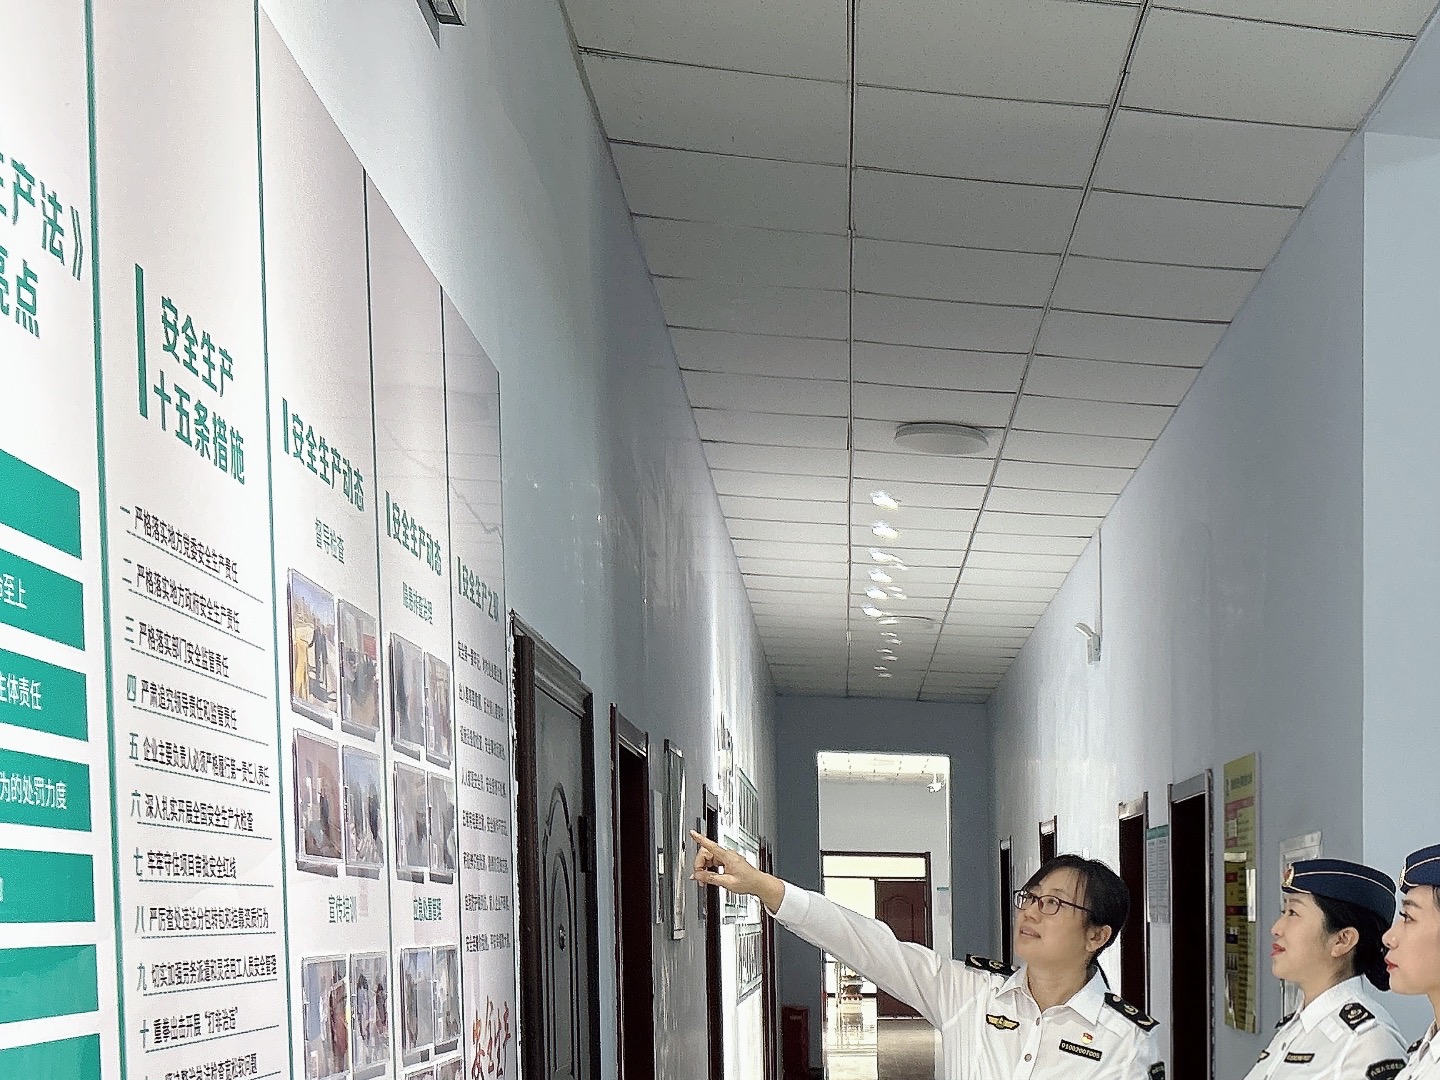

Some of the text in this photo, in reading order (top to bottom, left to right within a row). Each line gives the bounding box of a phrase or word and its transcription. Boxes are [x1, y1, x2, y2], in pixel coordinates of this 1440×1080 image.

[0, 153, 83, 281] 产法》
[162, 296, 233, 397] 安全生产
[154, 369, 245, 485] 十五条措施
[292, 413, 364, 511] 安全生产动态
[391, 501, 442, 575] 安全生产动态
